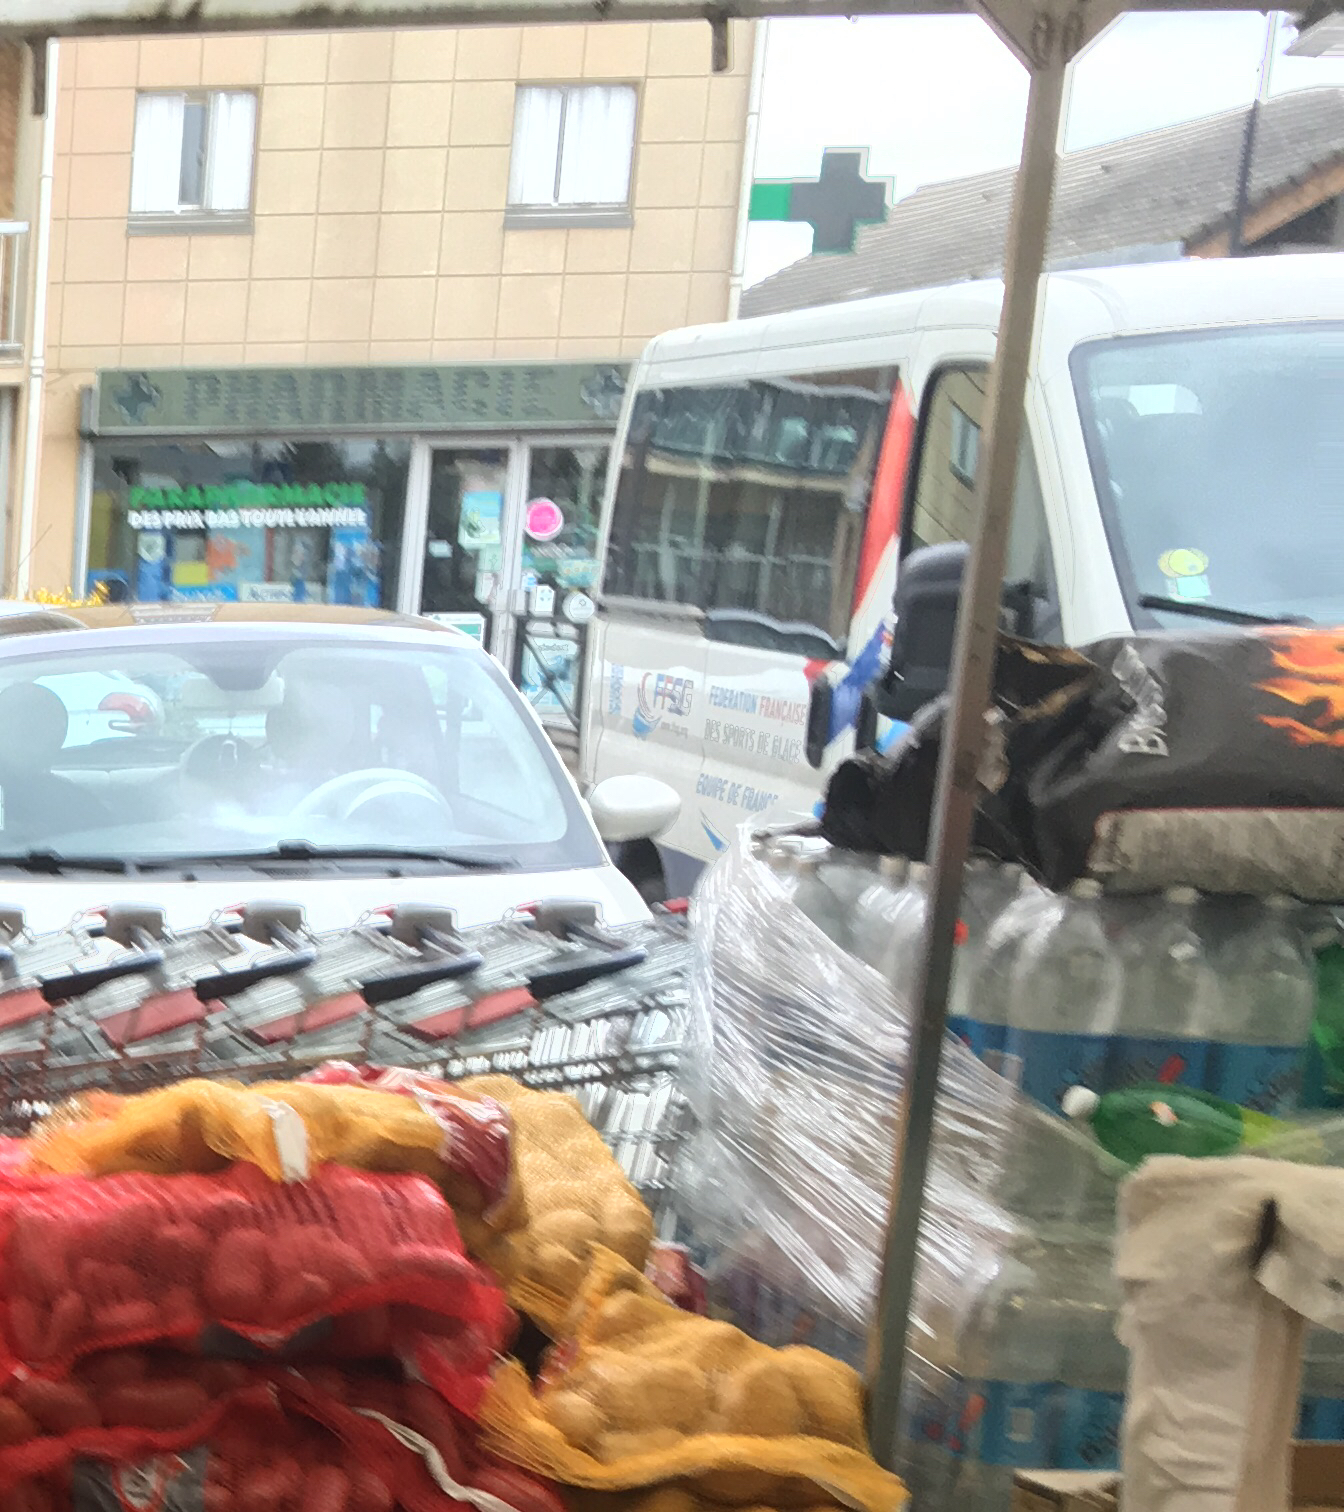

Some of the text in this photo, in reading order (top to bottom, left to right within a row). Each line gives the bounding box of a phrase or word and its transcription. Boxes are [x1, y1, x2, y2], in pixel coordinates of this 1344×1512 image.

[184, 366, 555, 421] PHARMACIE
[128, 509, 161, 529] DES
[163, 509, 204, 529] PRIX
[206, 508, 239, 528] BAS
[239, 508, 293, 528] TOUTE
[759, 695, 807, 726] FRANÇAISE
[704, 718, 722, 743] DES
[722, 722, 756, 752] SPORTS
[756, 731, 771, 756] DE
[771, 735, 802, 764] GLACE
[727, 782, 743, 806] DE
